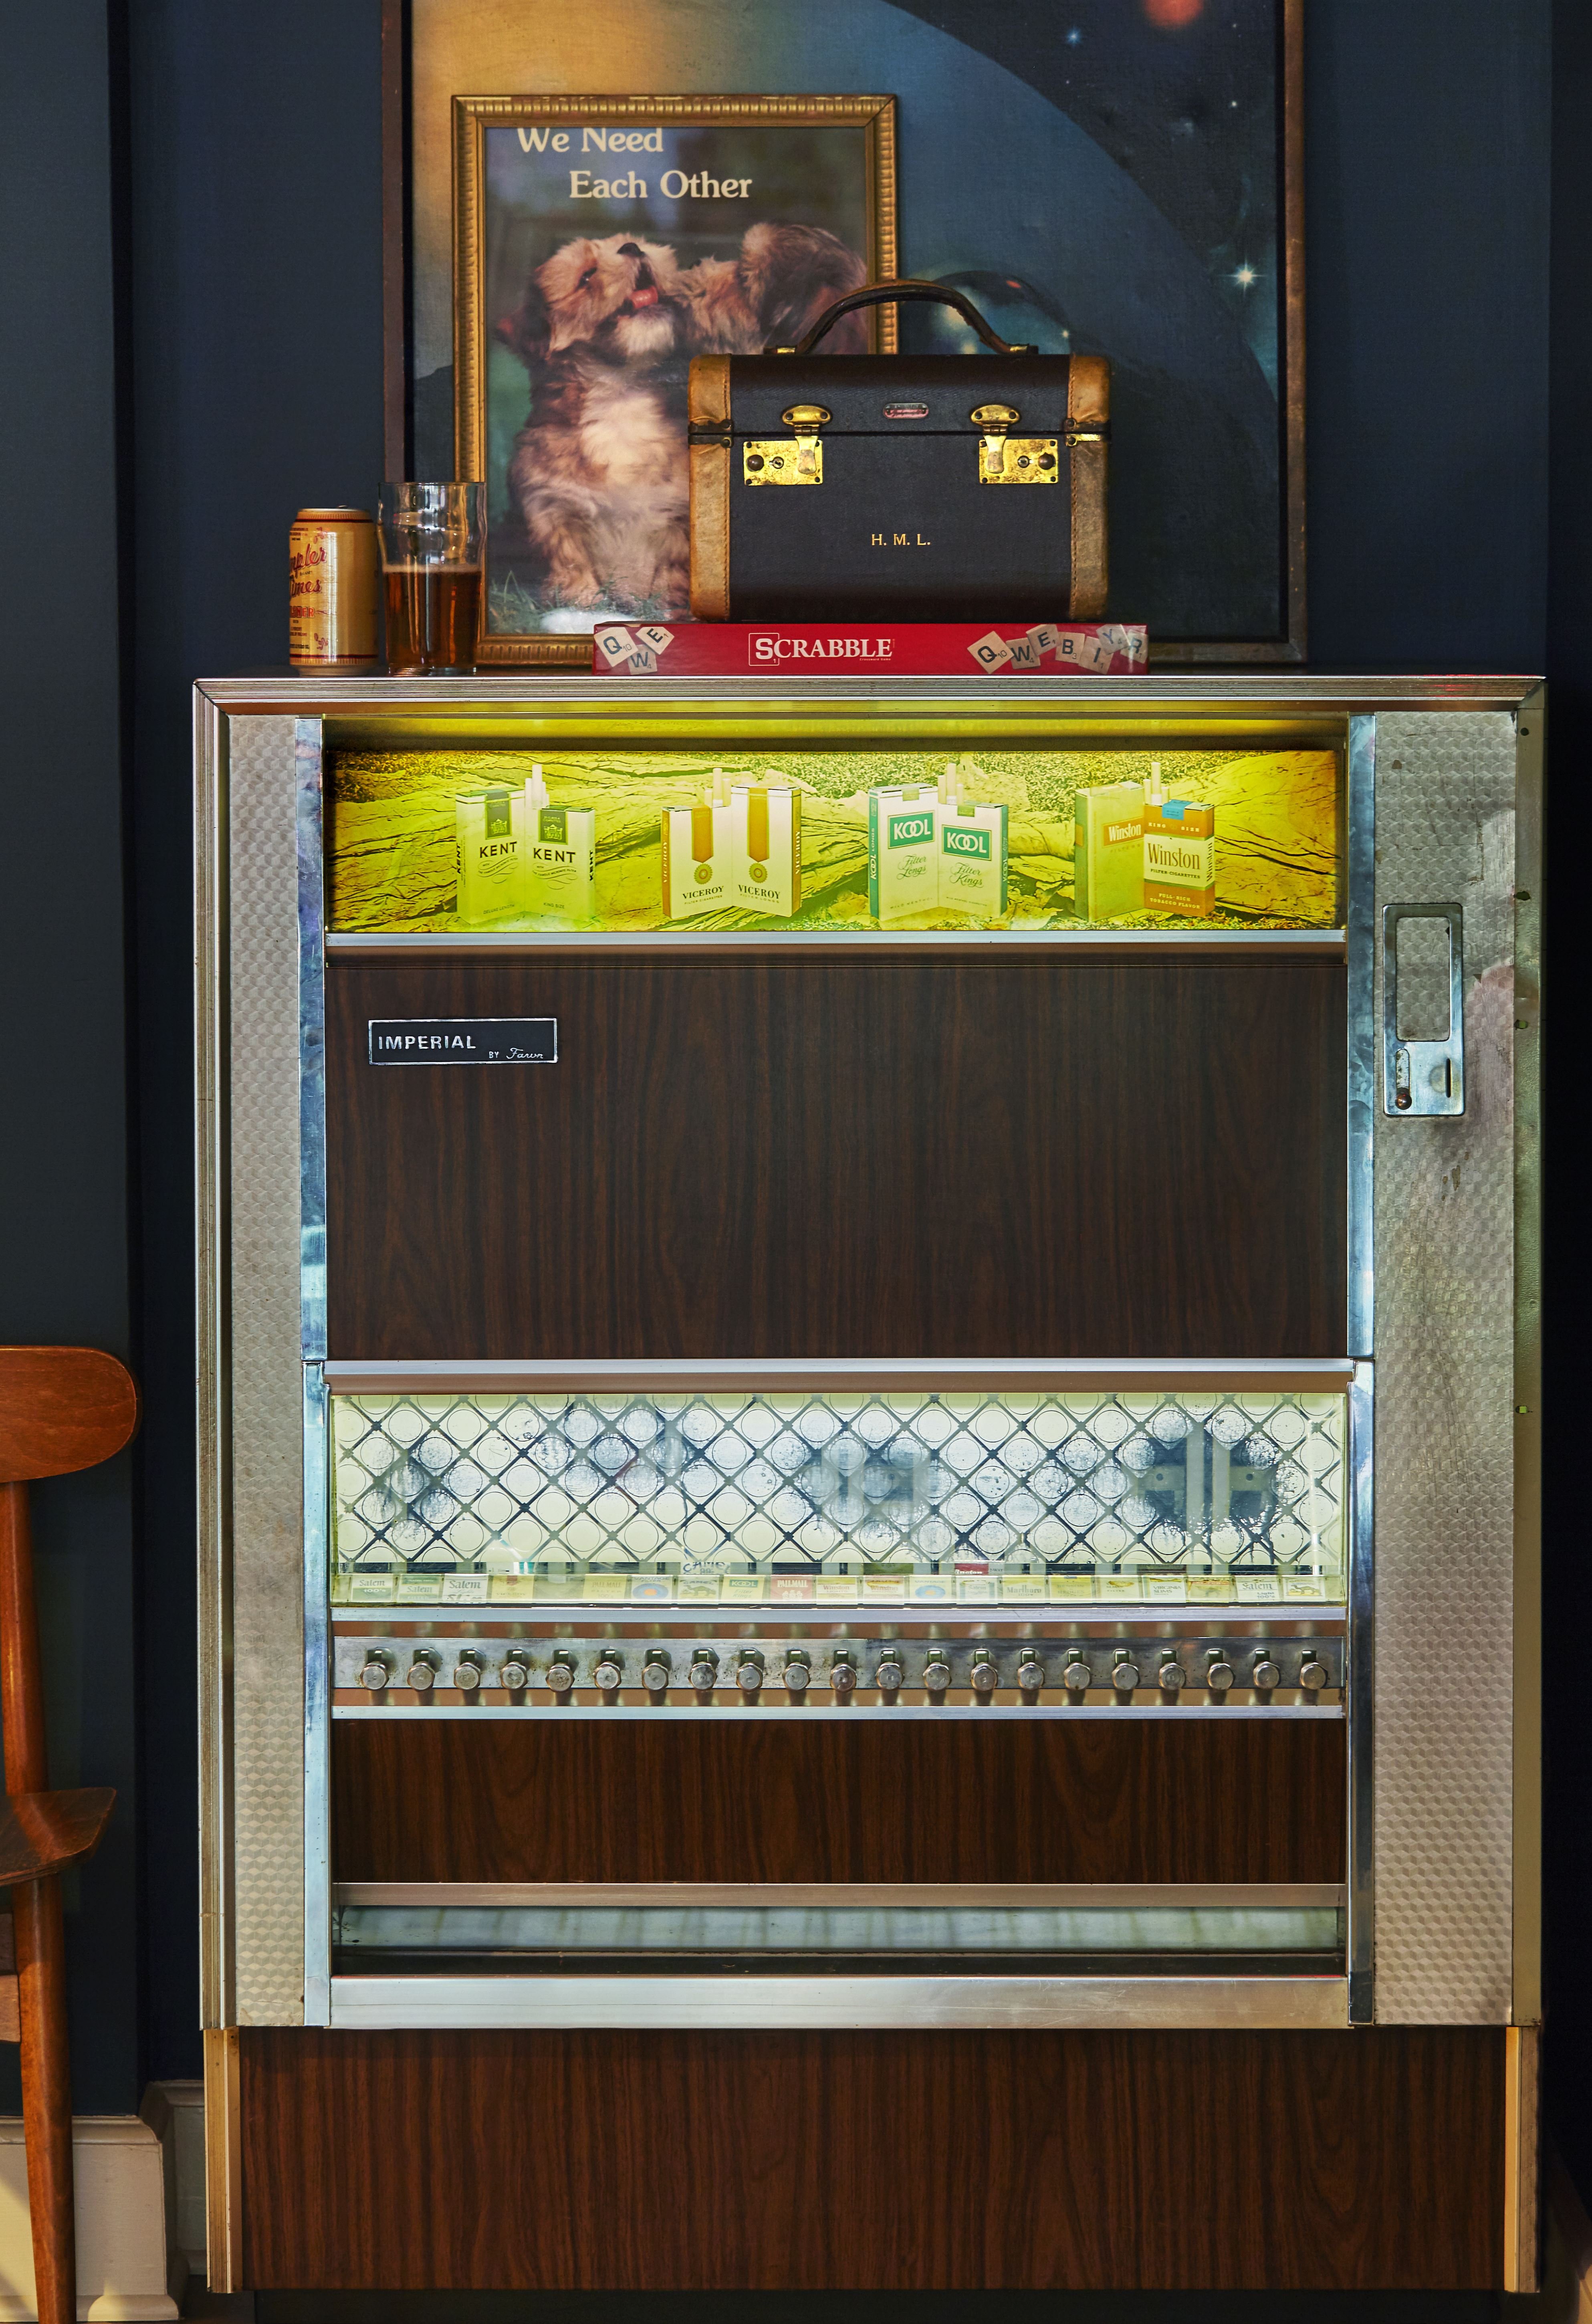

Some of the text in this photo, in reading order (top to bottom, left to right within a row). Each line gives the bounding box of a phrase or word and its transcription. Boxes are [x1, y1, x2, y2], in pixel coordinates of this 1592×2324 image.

[518, 127, 664, 153] We Need
[569, 170, 752, 198] Each Other
[872, 533, 931, 546] H. M. L.
[755, 638, 892, 660] SCRABBLE
[894, 819, 931, 840] KOOL
[1108, 823, 1141, 842] Winston
[480, 842, 517, 858] KENT
[947, 832, 987, 854] KOOL
[1110, 844, 1141, 853] FILTERS
[533, 848, 576, 863] KENT
[898, 854, 927, 870] Filter
[1147, 843, 1200, 870] Winston
[896, 865, 927, 880] Longs
[950, 862, 981, 876] Filter
[949, 874, 984, 888] Kings
[682, 886, 724, 899] VICEROY
[738, 884, 781, 899] VICEROY
[1150, 897, 1201, 909] TOBACCO FLAVOR
[378, 1035, 476, 1050] IMPERIAL
[449, 1580, 481, 1589] Salem
[1007, 1585, 1042, 1593] Marlboro
